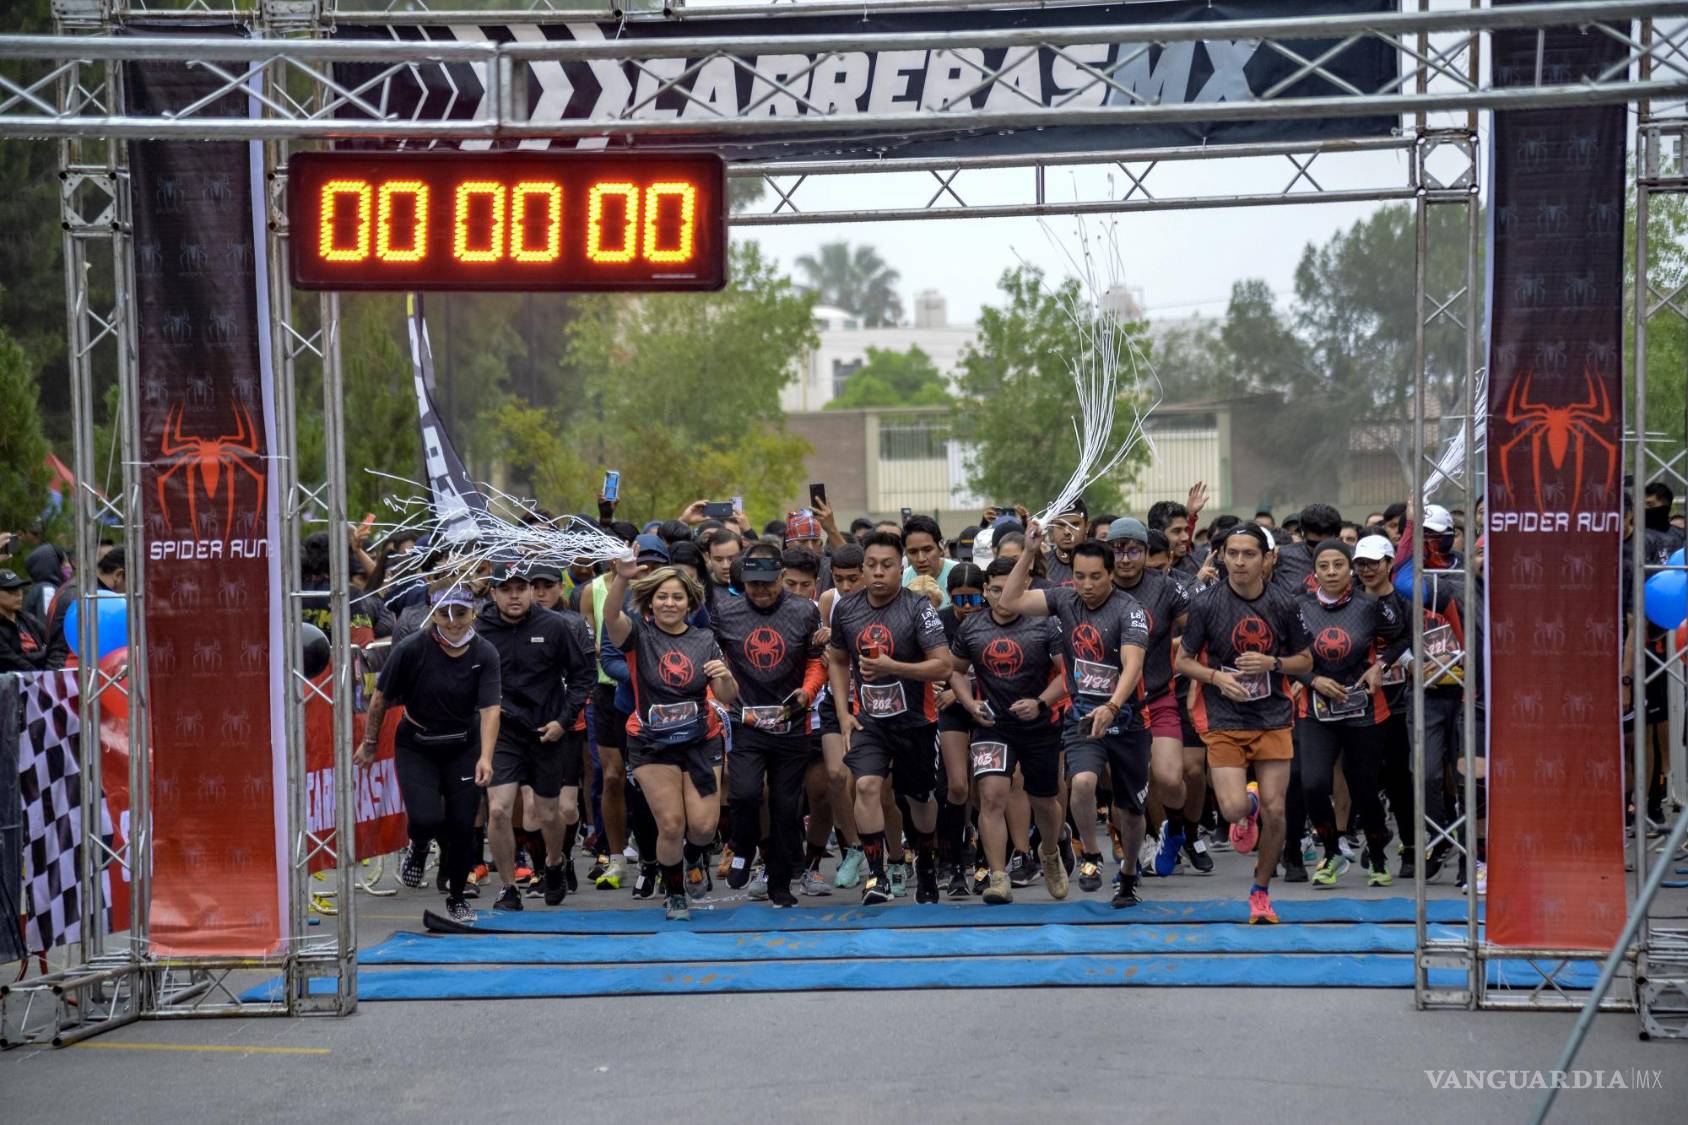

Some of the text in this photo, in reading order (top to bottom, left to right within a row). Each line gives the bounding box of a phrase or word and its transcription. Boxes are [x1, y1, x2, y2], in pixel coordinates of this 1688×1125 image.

[631, 39, 1263, 121] CARRERASMX
[319, 180, 697, 264] 00 00 00
[1490, 511, 1620, 533] SPIDER RUN
[150, 538, 268, 560] SPIDER RUN
[1081, 673, 1111, 690] 482
